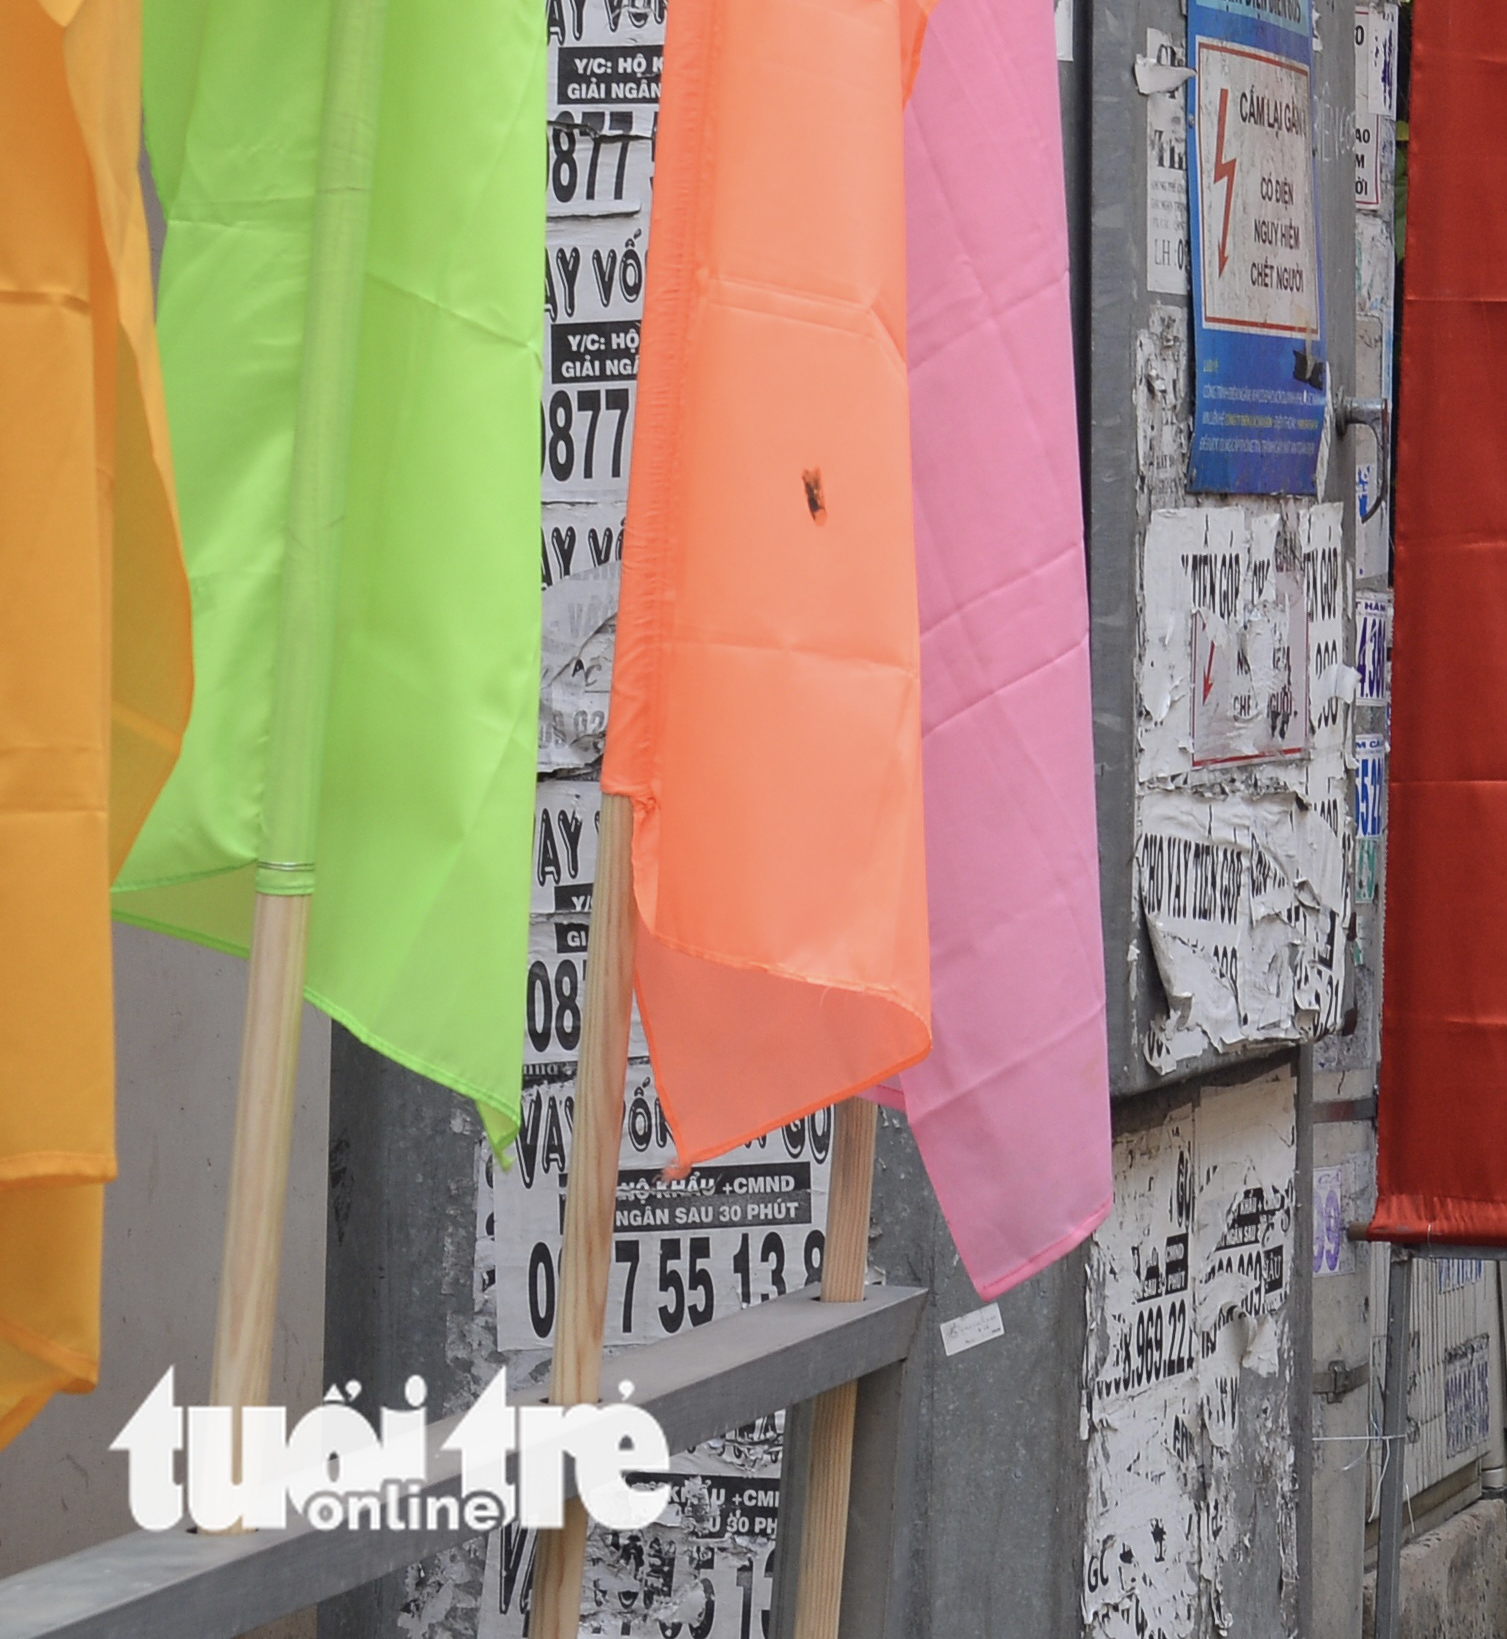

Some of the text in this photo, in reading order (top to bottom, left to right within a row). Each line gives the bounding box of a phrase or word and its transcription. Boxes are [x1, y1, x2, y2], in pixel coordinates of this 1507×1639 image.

[574, 57, 612, 76] Y/C:
[618, 53, 647, 78] HỘ
[567, 77, 606, 100] GIẢI
[1239, 84, 1265, 127] CẤM
[545, 110, 634, 204] 877
[1260, 176, 1273, 202] CÓ
[1254, 219, 1279, 245] NGUY
[593, 229, 649, 309] VỐ
[1250, 254, 1274, 290] CHẾT
[567, 328, 640, 353] Y/C: HỘ
[561, 354, 601, 378] GIẢI
[541, 388, 630, 483] 877
[1168, 836, 1192, 919] VAY
[526, 959, 588, 1052] 08
[722, 1174, 796, 1198] +CMND
[616, 1198, 799, 1227] NGÂN SAU 30 PHÚT
